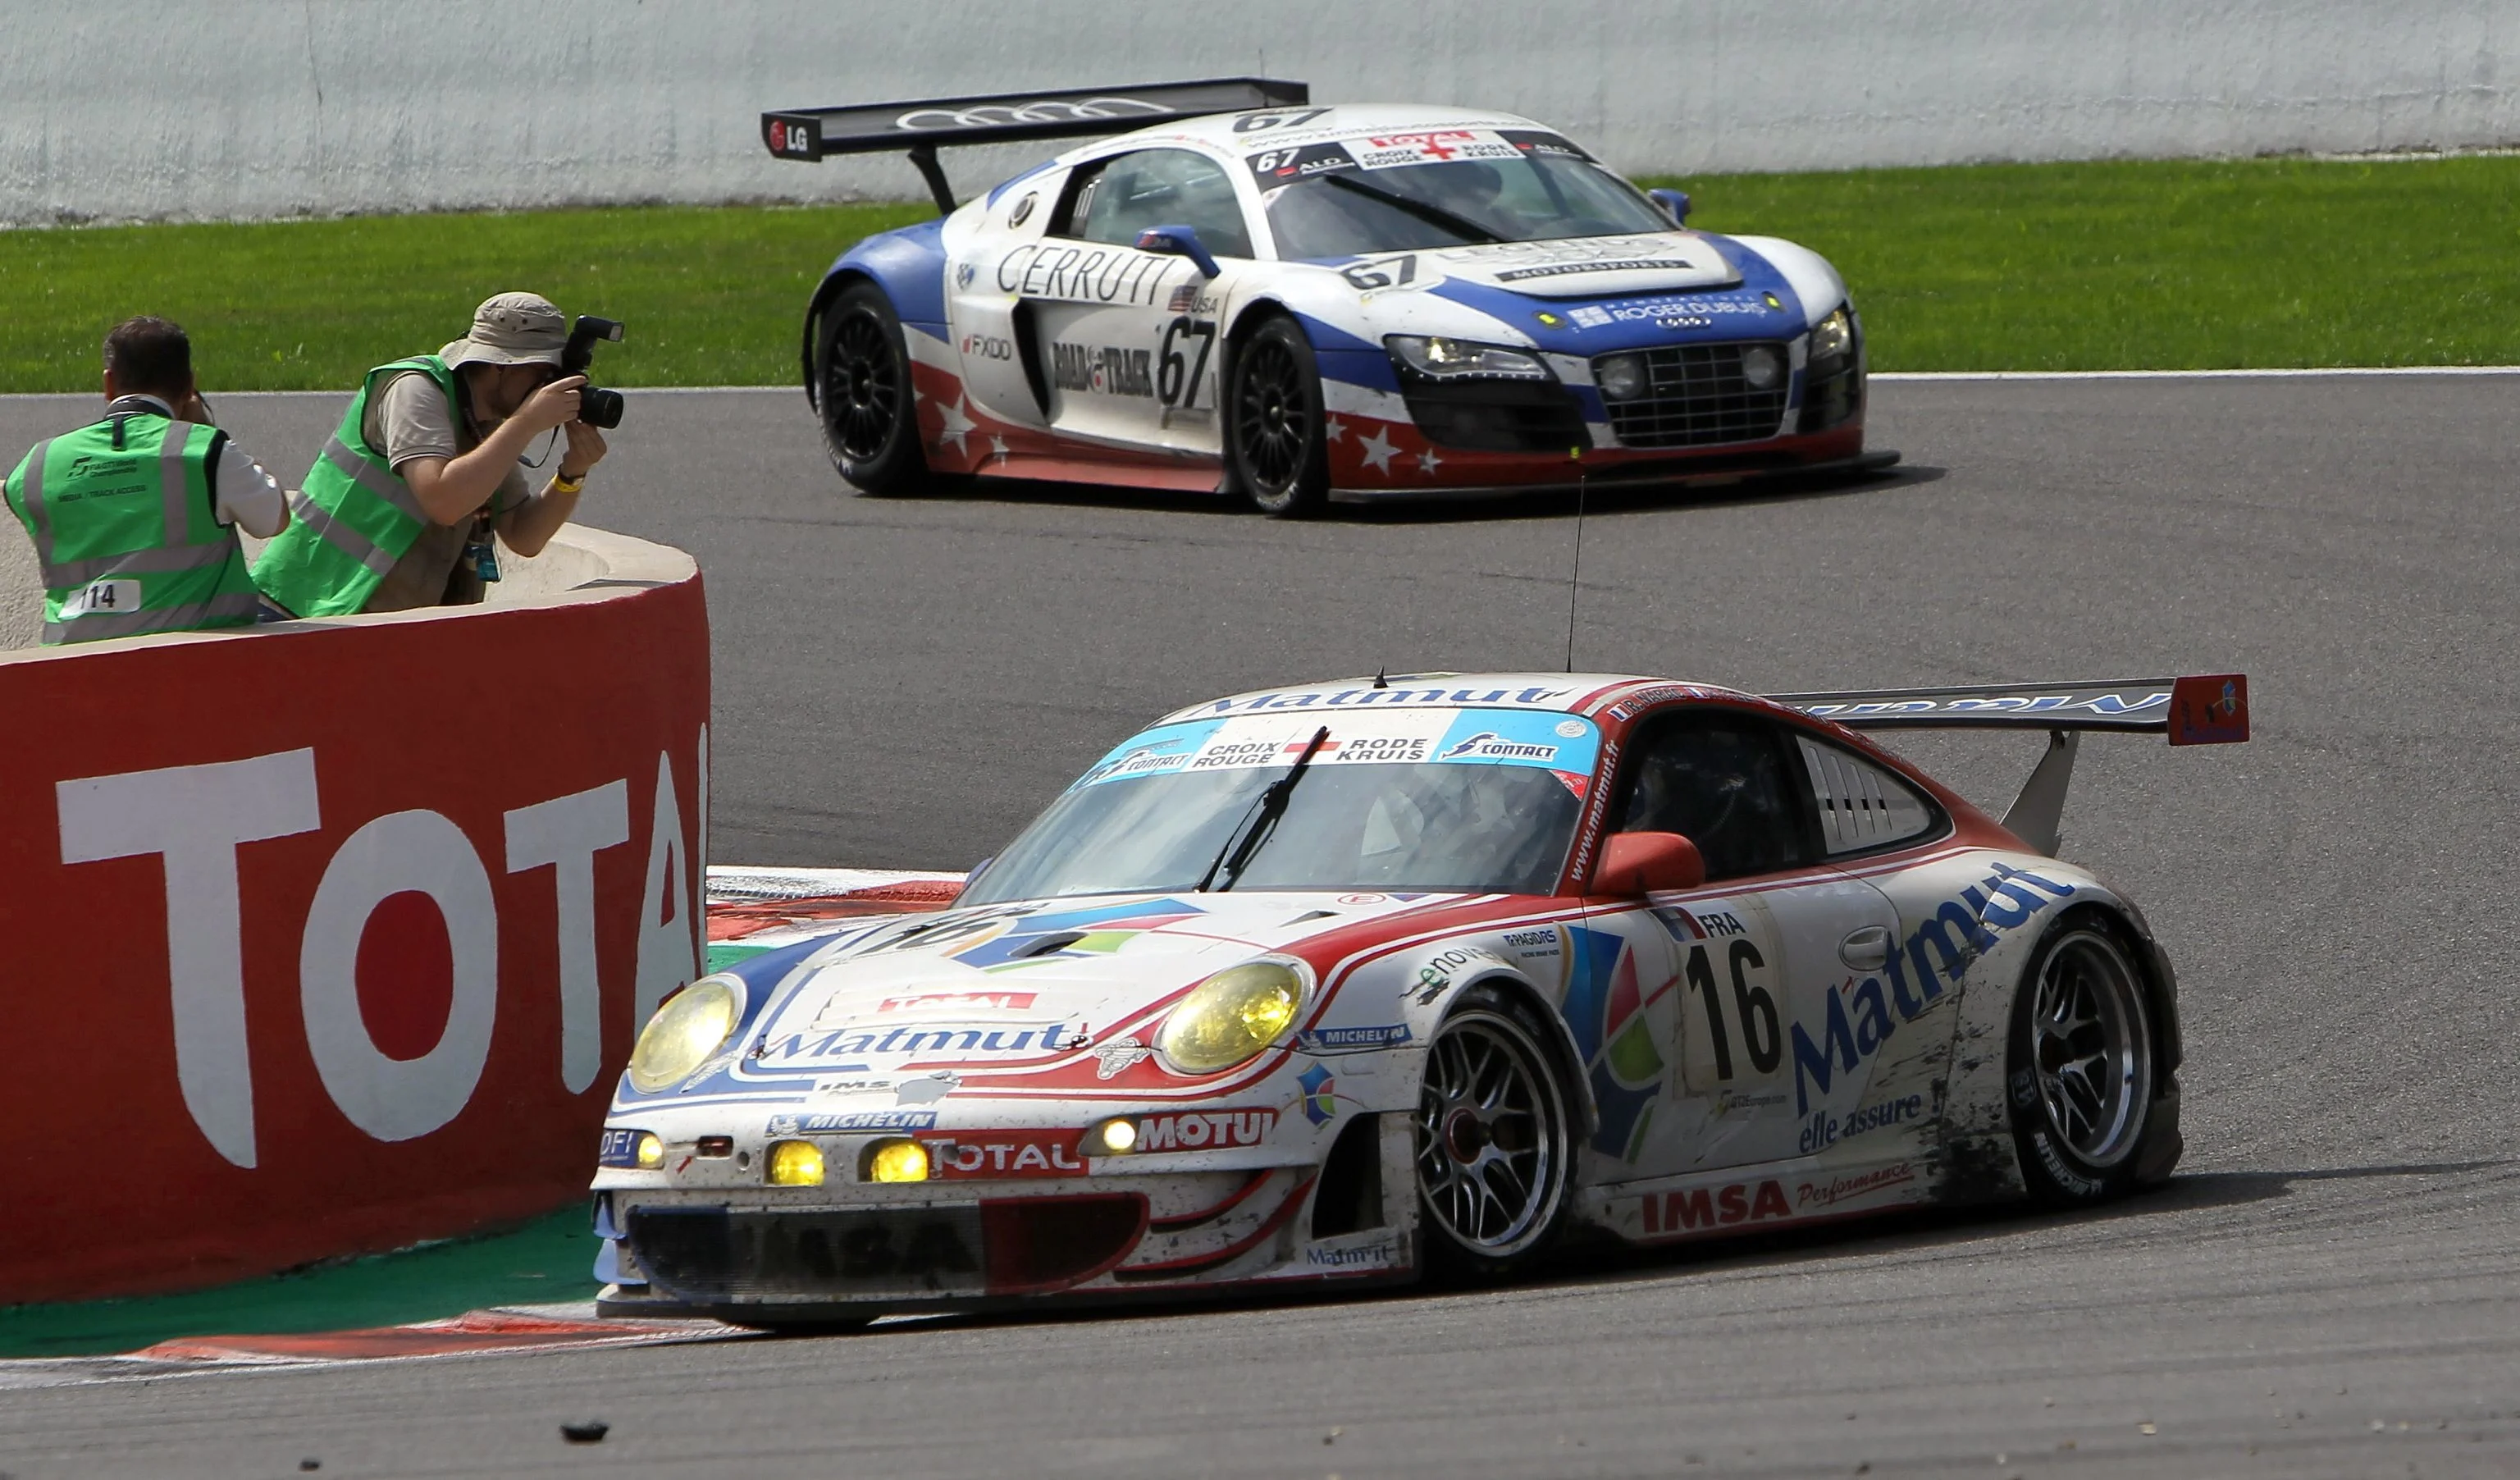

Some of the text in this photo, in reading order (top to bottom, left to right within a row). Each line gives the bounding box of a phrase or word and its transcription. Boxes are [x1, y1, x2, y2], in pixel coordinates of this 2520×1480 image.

[1232, 105, 1335, 133] 67
[787, 126, 808, 152] LG
[1256, 148, 1300, 173] 67
[1363, 149, 1423, 167] CROIX ROUGE
[998, 244, 1176, 305] CERRUTI
[1339, 254, 1418, 290] 67
[1191, 296, 1218, 314] USA
[1612, 304, 1688, 321] ROGER
[1157, 317, 1217, 408] 67
[1194, 686, 1559, 719] Matmut
[1127, 754, 1189, 771] CONTACT
[1194, 741, 1280, 766] CROIX ROUGE
[1335, 738, 1430, 761] RODE KRUIS
[1481, 744, 1556, 757] CONTACT
[1571, 739, 1620, 882] www.matmut.fr
[1698, 911, 1746, 938] FRA
[1790, 861, 2075, 1120] Matmut
[1685, 939, 1782, 1081] 16
[767, 1023, 1075, 1060] Matmut
[1326, 1026, 1406, 1044] MICHELIN
[806, 1112, 933, 1131] MICHELIN
[1800, 1111, 1838, 1153] elle
[1843, 1093, 1921, 1138] assure
[921, 1138, 1080, 1179] TOTAL
[1796, 1161, 1911, 1208] Performance
[1642, 1179, 1792, 1234] IMSA
